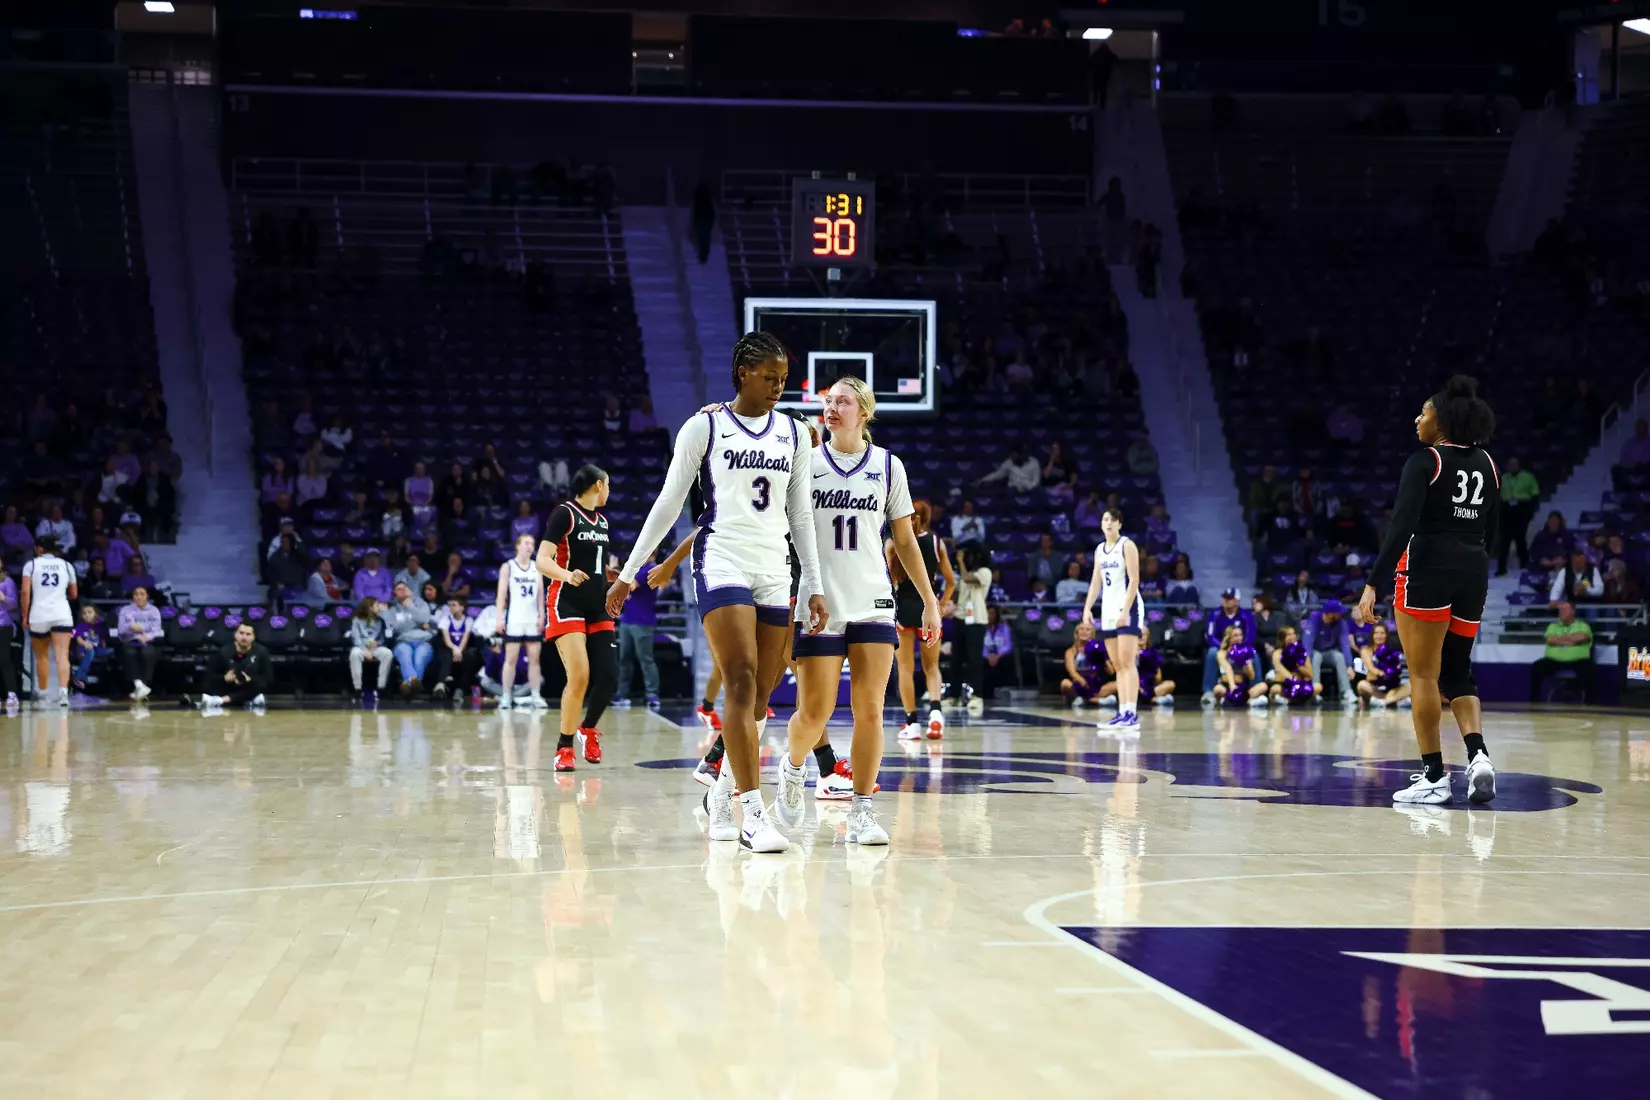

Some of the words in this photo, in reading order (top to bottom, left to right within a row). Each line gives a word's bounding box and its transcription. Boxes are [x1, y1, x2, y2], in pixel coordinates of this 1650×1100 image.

[826, 193, 862, 216] 1:31
[812, 216, 856, 256] 30
[723, 449, 790, 472] Wildcats
[751, 475, 771, 512] 3
[1451, 469, 1484, 505] 32
[812, 489, 878, 511] Wildcats
[1453, 506, 1479, 520] THOMAS
[832, 514, 858, 551] 11
[595, 545, 603, 574] 1
[41, 572, 59, 587] 23
[520, 585, 534, 598] 34
